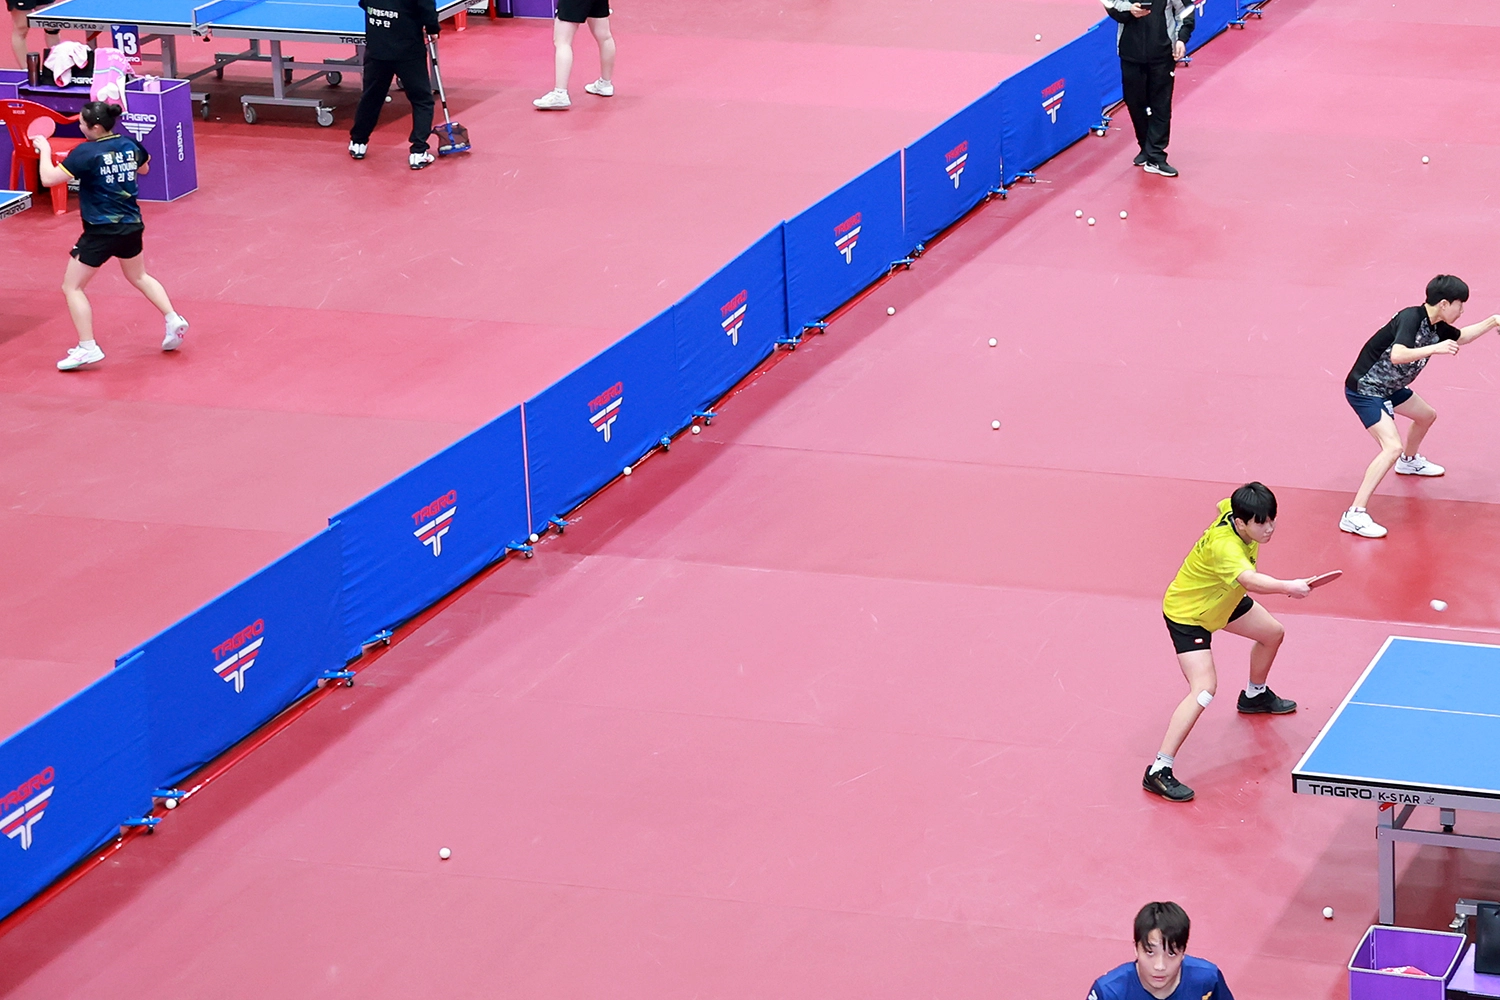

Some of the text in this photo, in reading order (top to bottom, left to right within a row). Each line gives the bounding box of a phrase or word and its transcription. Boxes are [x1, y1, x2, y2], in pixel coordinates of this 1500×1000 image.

[36, 20, 71, 29] TAGRO
[114, 32, 138, 56] 13
[122, 113, 157, 122] TAGRO
[176, 122, 185, 161] TAGRO
[412, 490, 457, 525] TAGRO
[212, 618, 265, 660] TAGRO
[1309, 784, 1421, 806] TAGRO K-STAR
